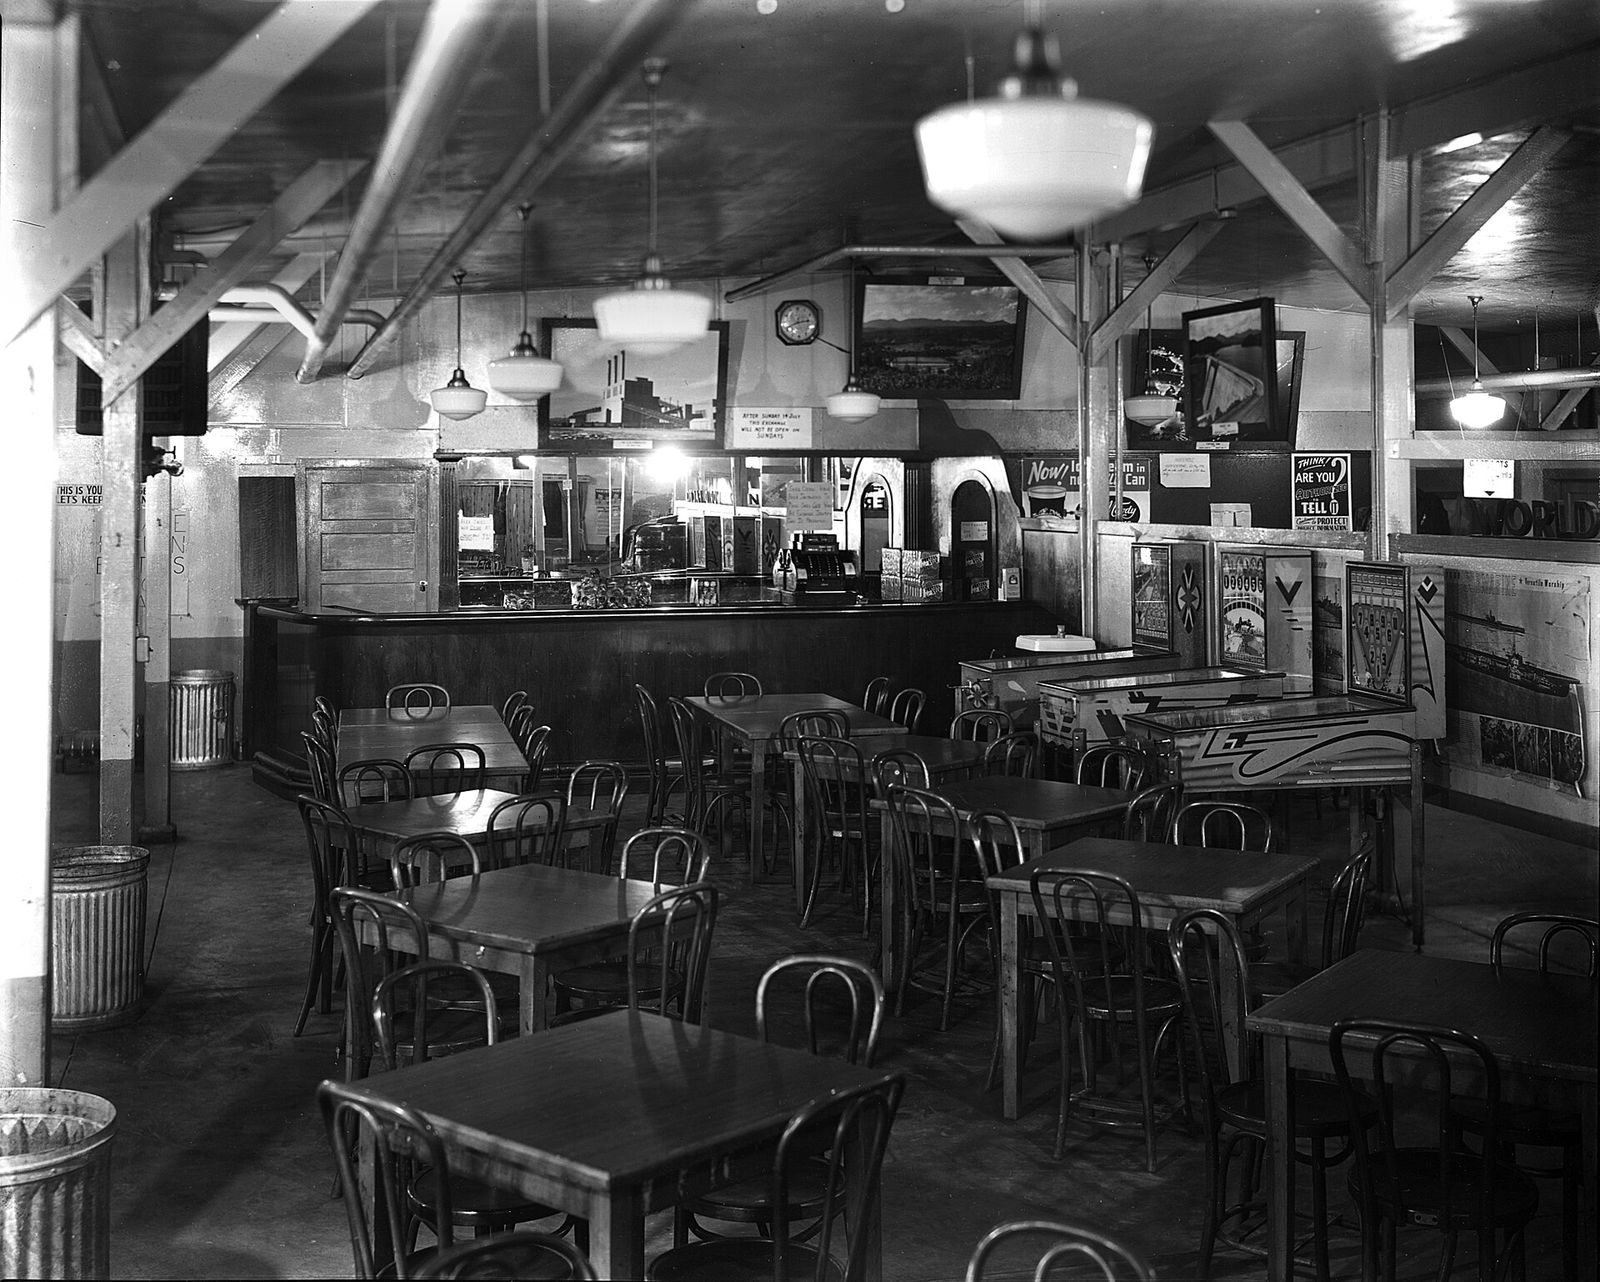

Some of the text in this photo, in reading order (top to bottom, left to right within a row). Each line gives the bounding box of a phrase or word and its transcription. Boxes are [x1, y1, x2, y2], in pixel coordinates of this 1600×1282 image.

[1298, 457, 1332, 469] THINK!
[1028, 460, 1069, 486] Now!
[1136, 463, 1146, 473] in
[1296, 472, 1314, 483] ARE
[1316, 472, 1336, 483] YOU
[1126, 473, 1146, 486] Can
[56, 486, 74, 495] THIS
[76, 486, 84, 495] IS
[82, 496, 103, 504] KEEP
[1301, 502, 1328, 514] TELL
